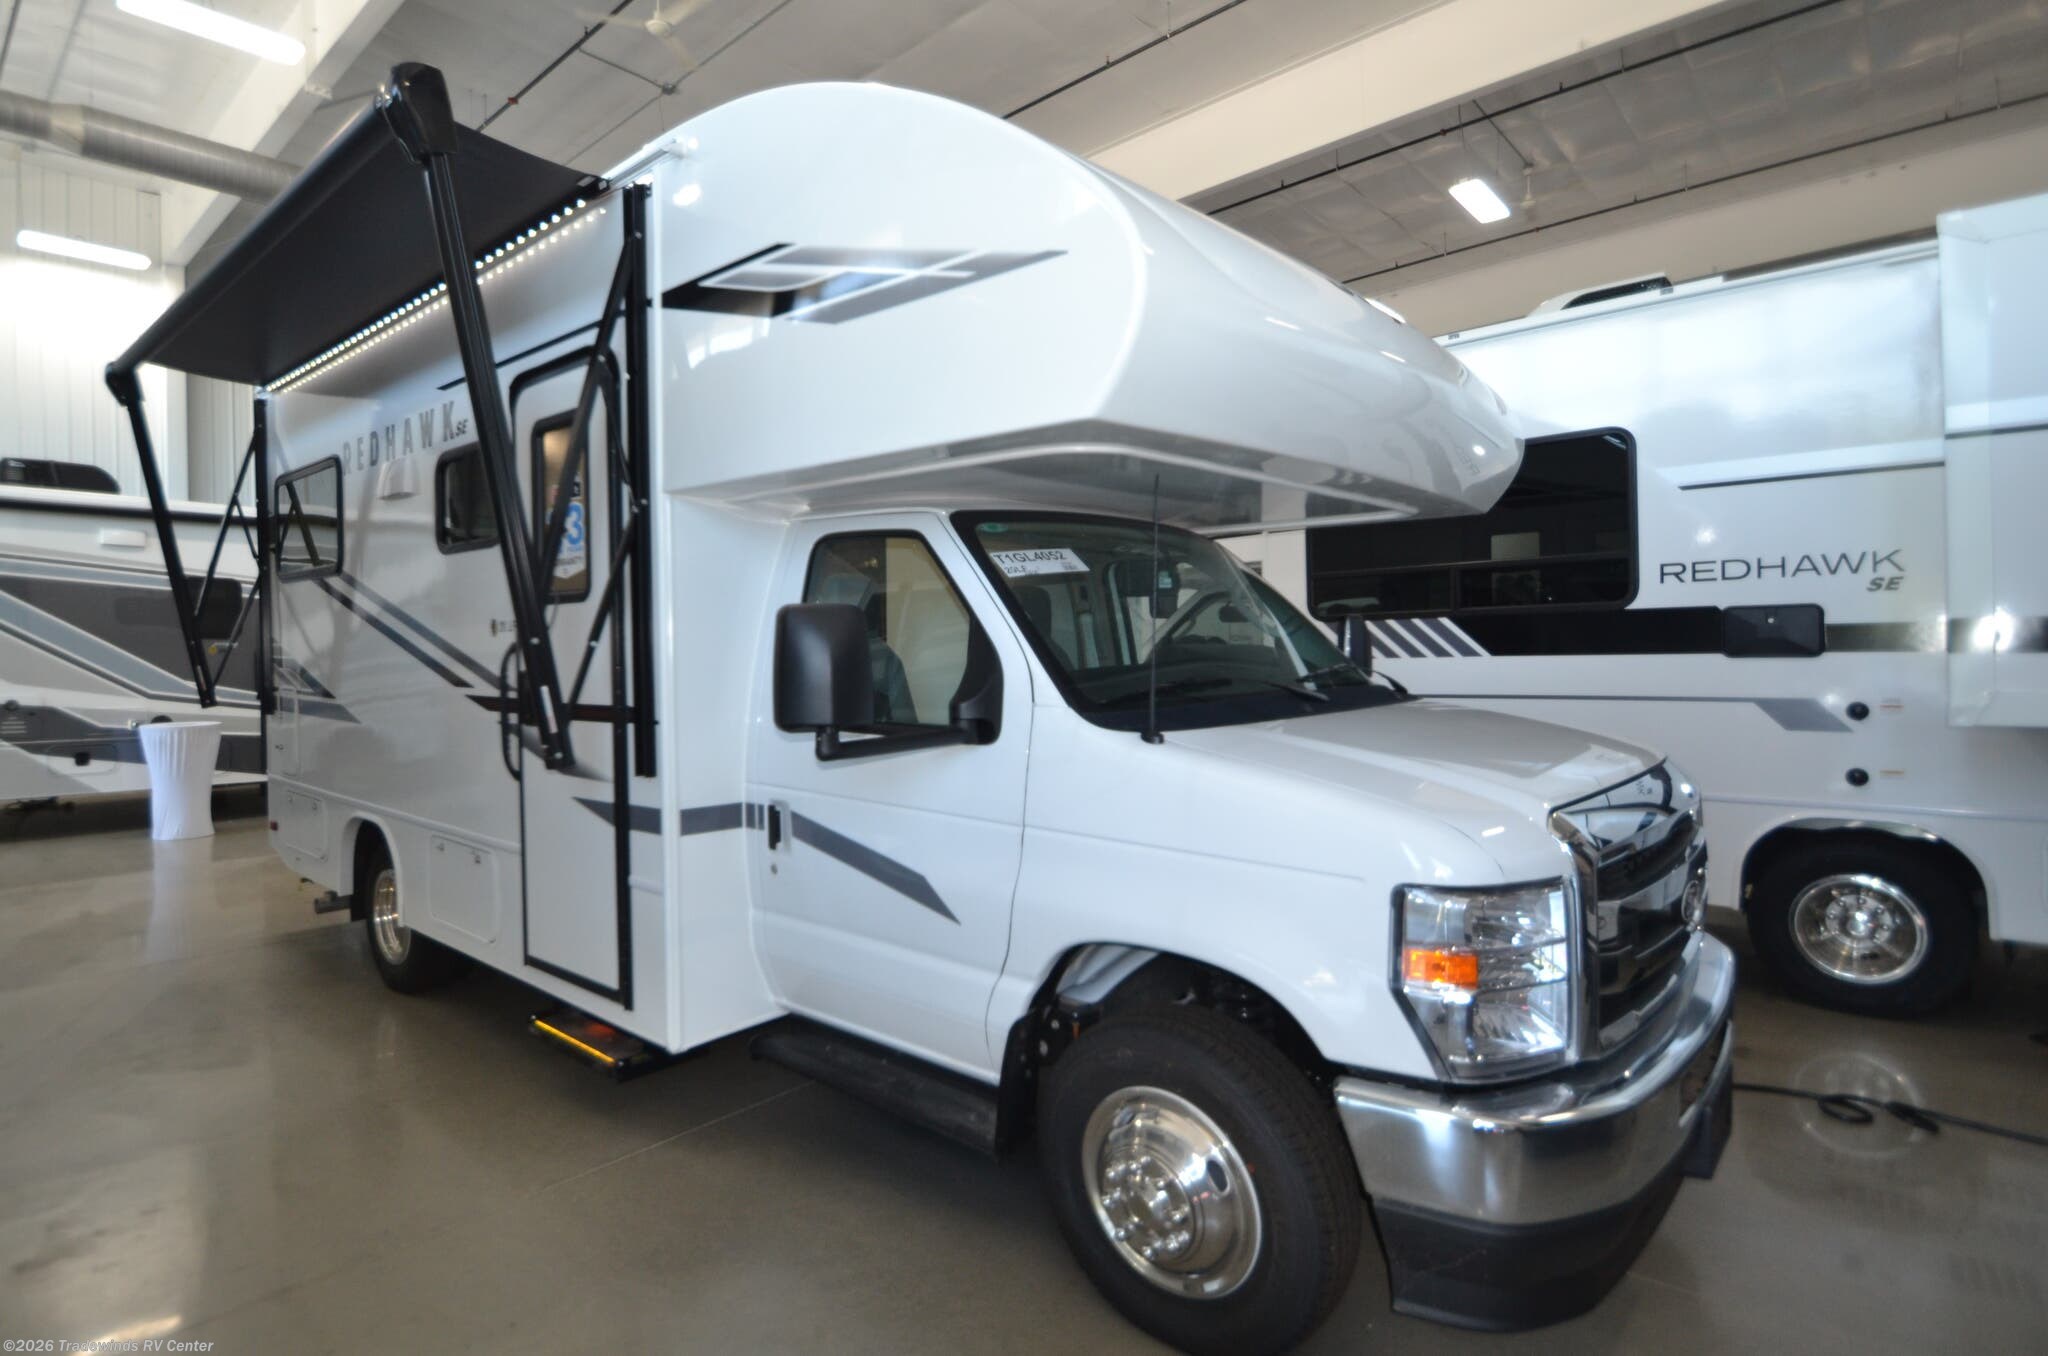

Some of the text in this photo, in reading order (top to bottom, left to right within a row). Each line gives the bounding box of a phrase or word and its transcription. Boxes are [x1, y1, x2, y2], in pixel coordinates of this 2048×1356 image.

[342, 400, 469, 476] REDHAWK SE
[993, 550, 1067, 564] T1GL4052
[1659, 548, 1905, 584] REDHAWK
[1866, 575, 1904, 592] SE
